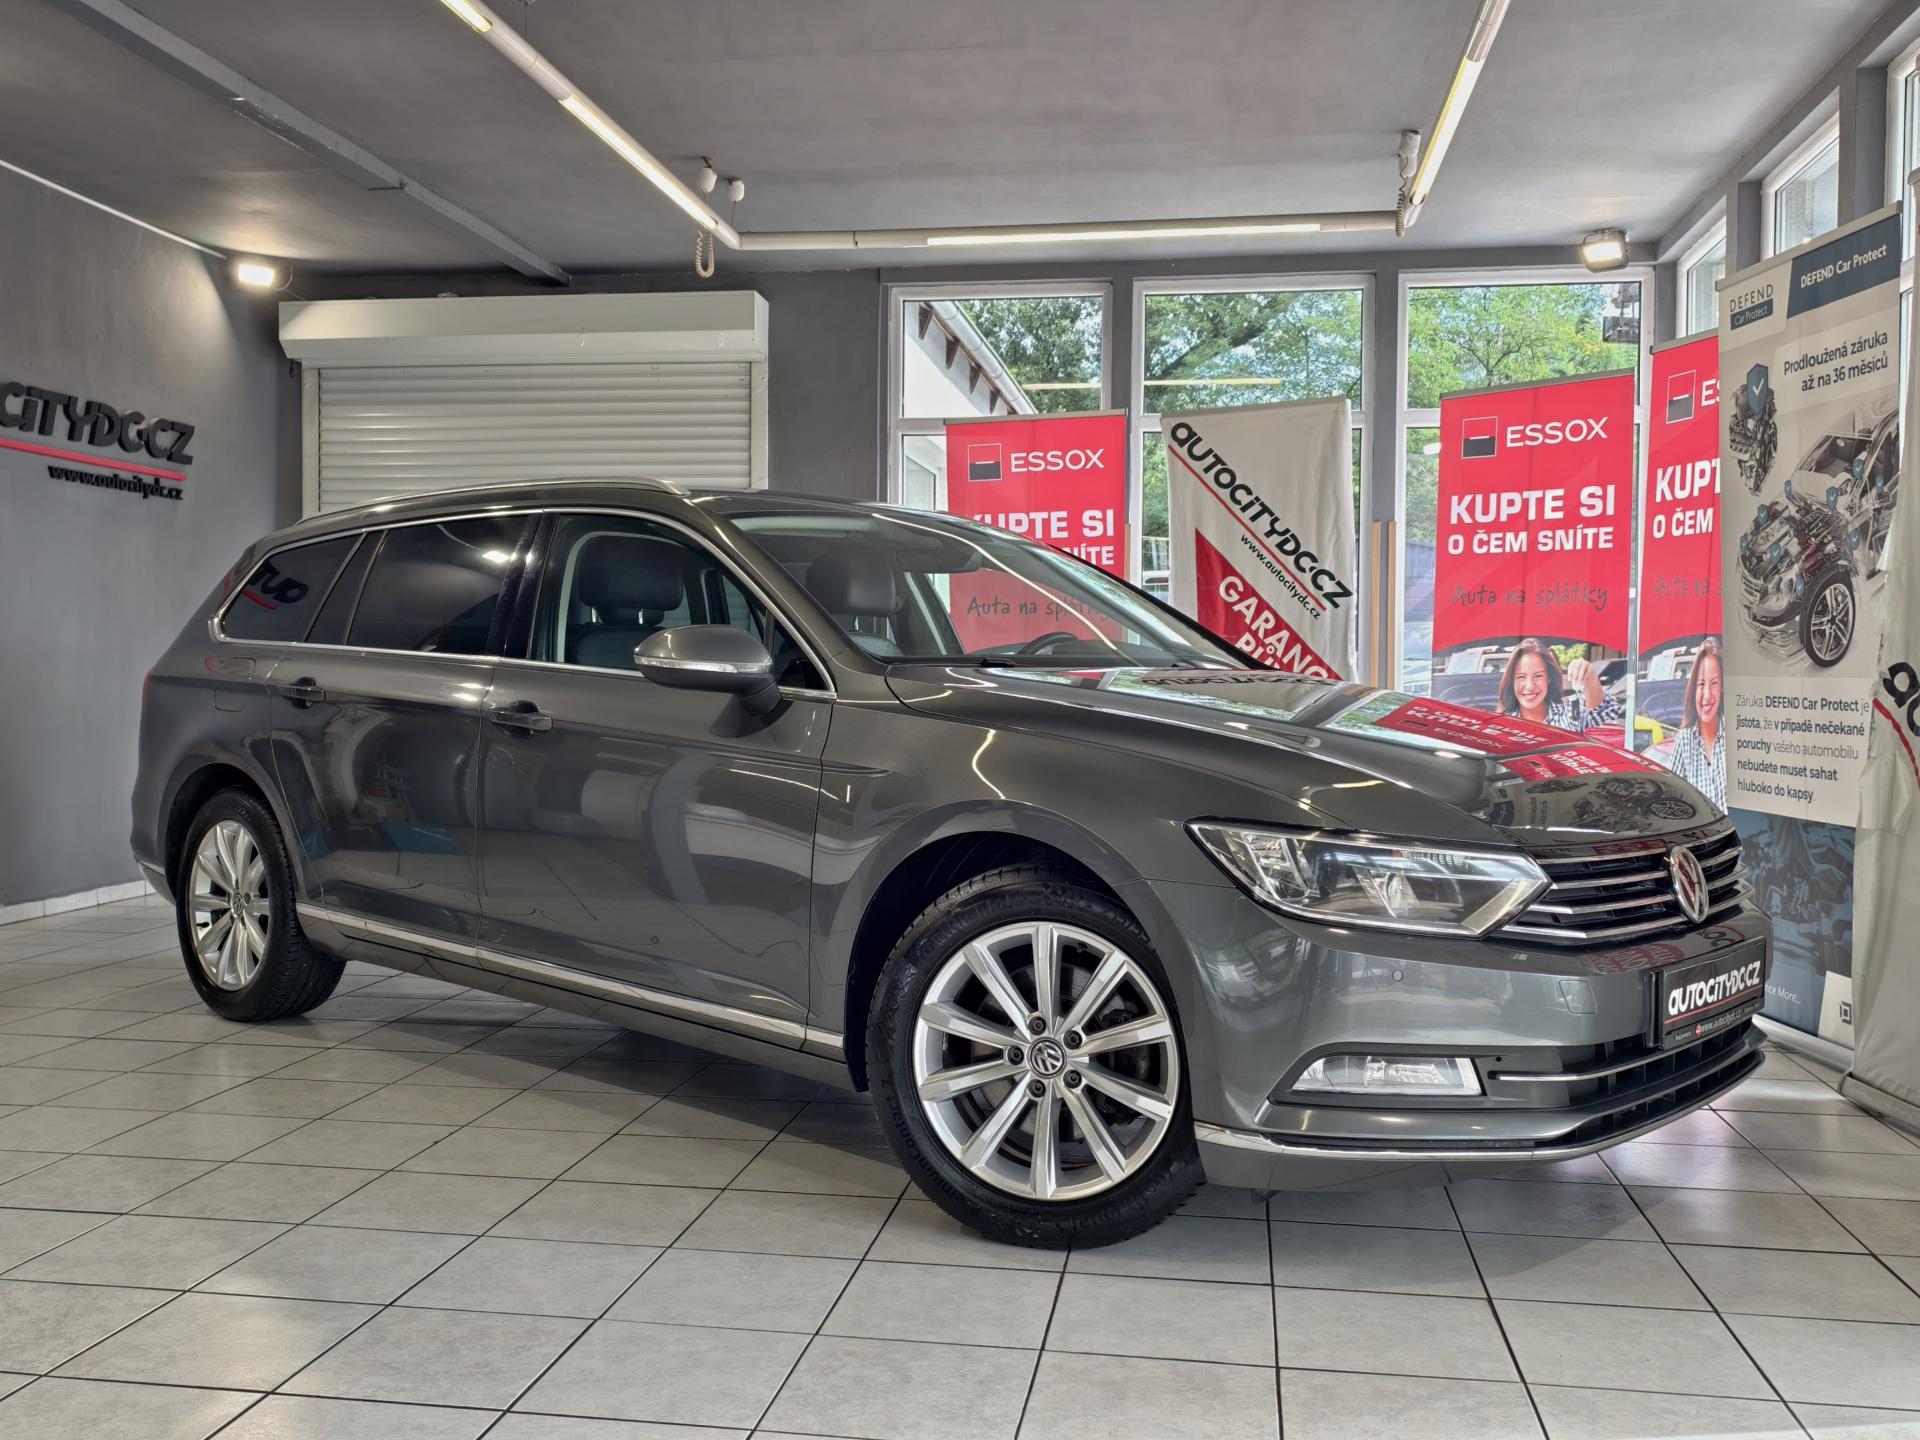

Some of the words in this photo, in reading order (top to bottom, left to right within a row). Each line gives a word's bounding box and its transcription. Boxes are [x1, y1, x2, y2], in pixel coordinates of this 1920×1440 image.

[1801, 264, 1834, 288] DEFEND
[1836, 260, 1851, 274] Car
[1853, 244, 1887, 268] Protect
[1729, 283, 1774, 313] DEFEND
[1734, 313, 1745, 326] Car
[1745, 305, 1768, 322] Protect
[1784, 341, 1848, 375] Prodloužená
[1850, 331, 1888, 355] záruka
[1801, 376, 1815, 392] až
[1817, 373, 1832, 386] na
[1833, 366, 1846, 384] 36
[1848, 351, 1888, 379] měsíců
[1506, 417, 1608, 448] ESSOX
[1011, 448, 1104, 473] ESSOX
[1450, 489, 1565, 524] KUPTE
[1579, 485, 1615, 517] SI
[1082, 509, 1114, 537] SI
[1653, 514, 1666, 538] O
[1671, 507, 1713, 537] ČEM
[1064, 543, 1114, 565] ÍTE
[1448, 534, 1464, 555] O
[1472, 529, 1527, 554] ČEM
[1537, 524, 1614, 552] SNÍTE
[1241, 534, 1320, 619] www.autocitydc.cz
[967, 595, 1010, 616] Auta
[1019, 601, 1037, 615] na
[1452, 584, 1497, 606] Auta
[1505, 590, 1526, 605] na
[1535, 581, 1608, 612] splátky
[1736, 694, 1764, 708] Záruka
[1765, 695, 1800, 709] DEFEND
[1802, 697, 1818, 711] Car
[1820, 698, 1859, 712] Protect
[1860, 698, 1870, 716] je
[1763, 716, 1773, 730] že
[1774, 721, 1780, 730] v
[1780, 719, 1813, 734] případě
[1814, 721, 1865, 736] nečekané
[1737, 738, 1772, 754] poruchy
[1772, 741, 1801, 755] vašeho
[1802, 743, 1859, 760] automobilu
[1737, 760, 1778, 774] nebudete
[1780, 765, 1808, 778] muset
[1809, 767, 1838, 781] sahat
[1737, 779, 1772, 795] hluboko
[1774, 782, 1786, 796] do
